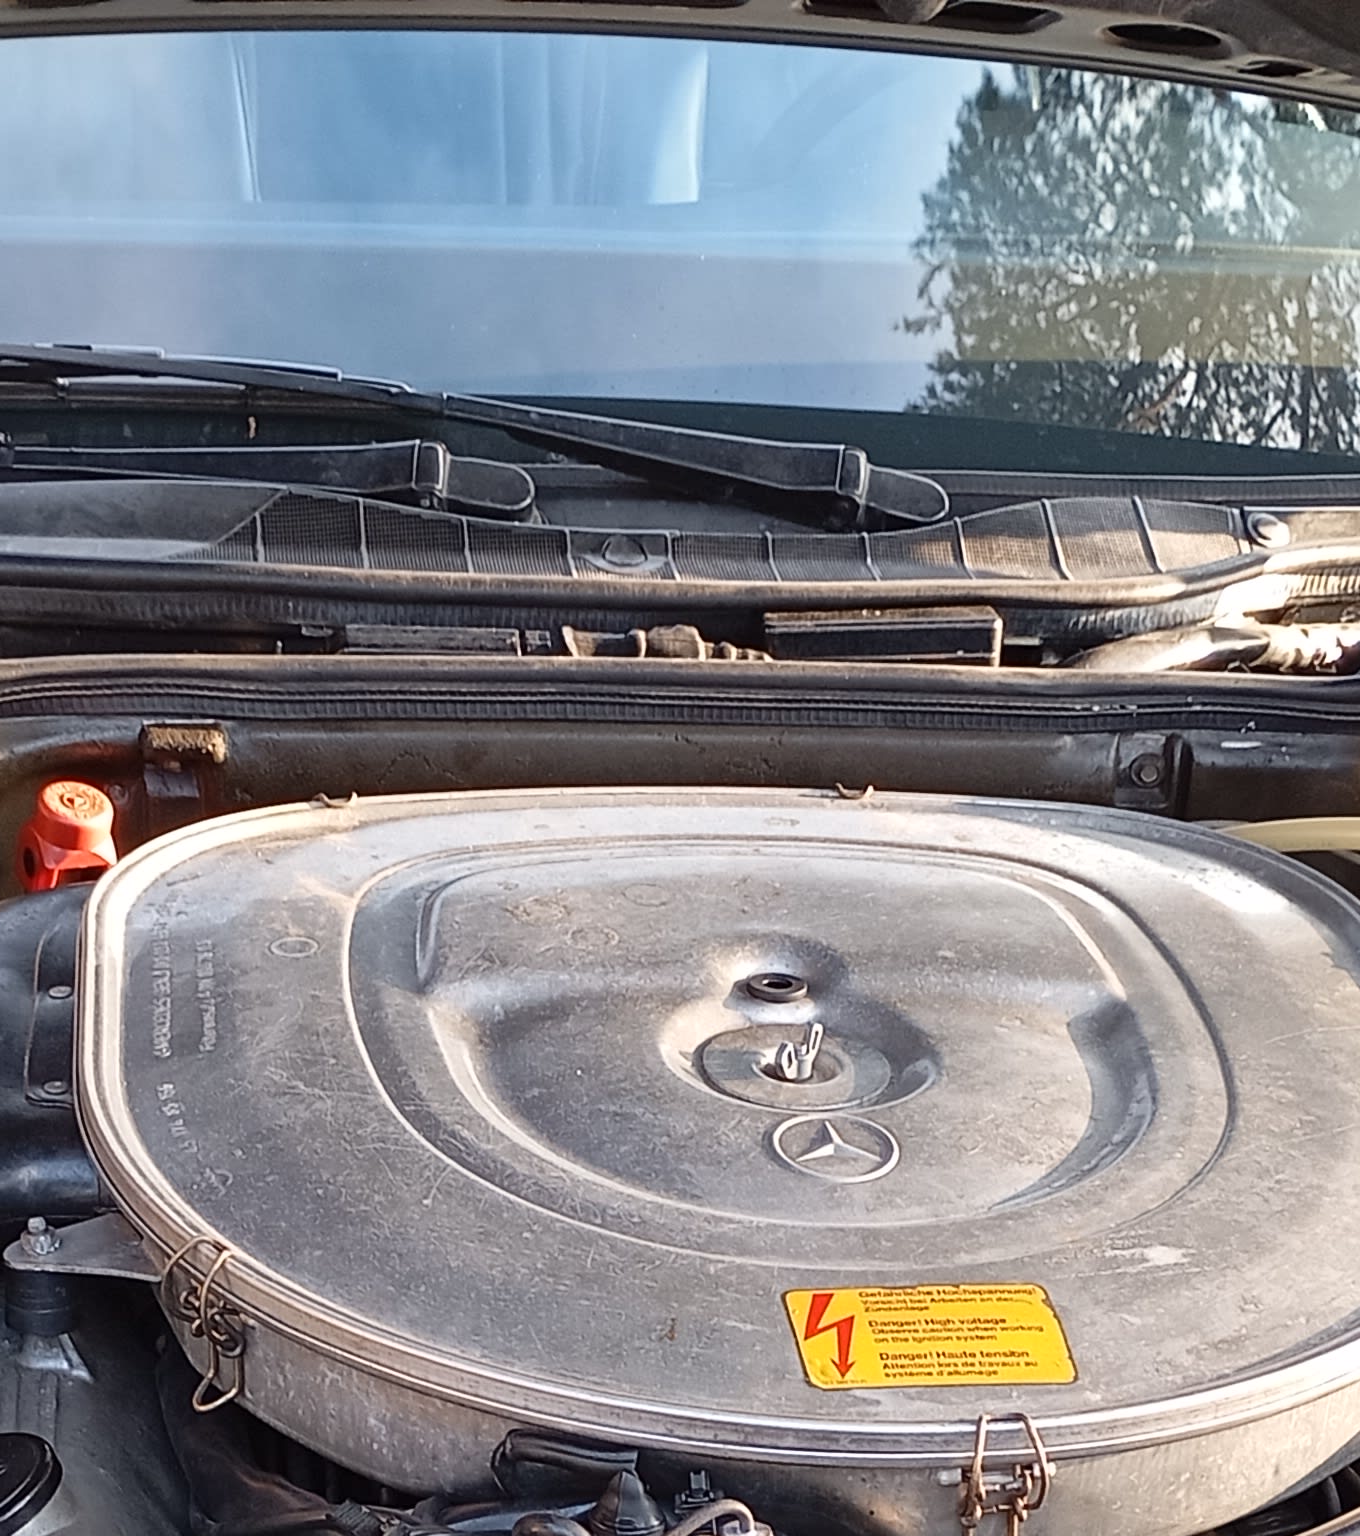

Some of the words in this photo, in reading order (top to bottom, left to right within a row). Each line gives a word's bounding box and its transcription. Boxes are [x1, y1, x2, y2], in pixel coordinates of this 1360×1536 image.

[868, 1319, 922, 1328] Danger!
[925, 1318, 956, 1327] High
[959, 1318, 1007, 1326] voltage
[879, 1352, 933, 1361] Danger!
[936, 1351, 977, 1359] Haute
[980, 1350, 1029, 1358] tension
[883, 1361, 935, 1370] Attention
[937, 1369, 998, 1378] d'allumage
